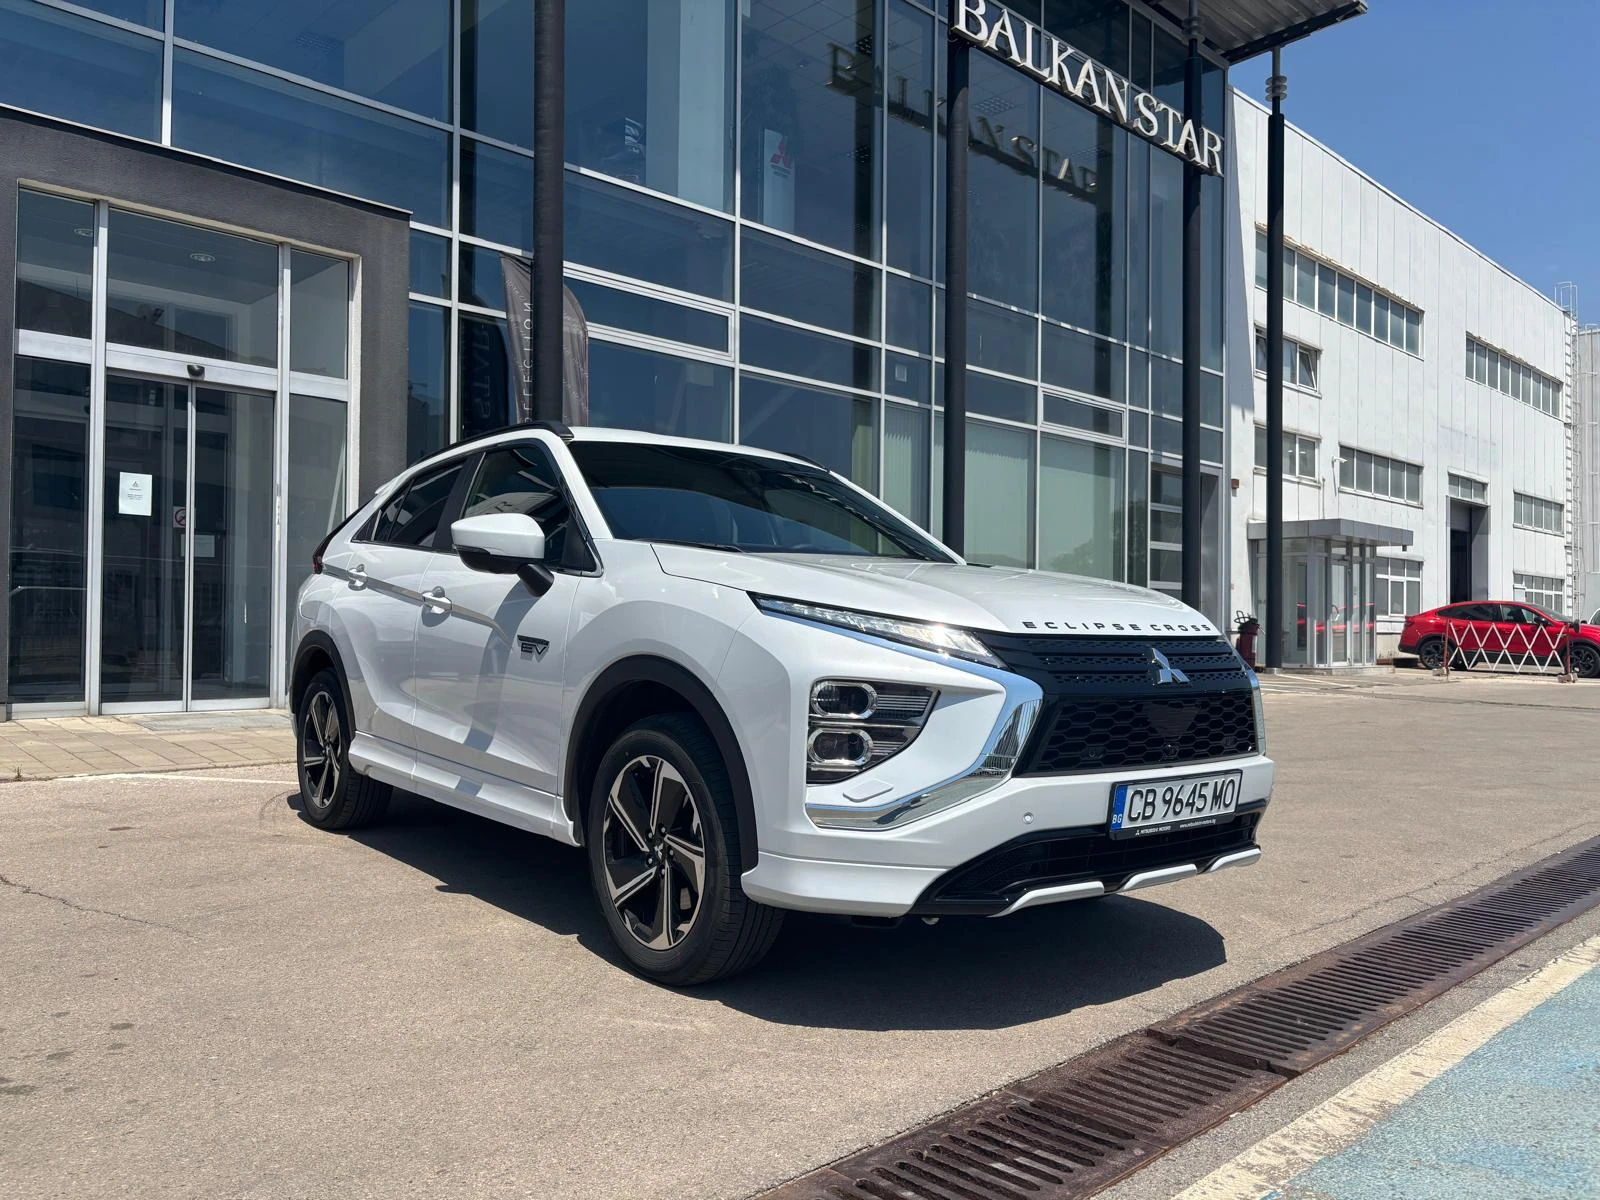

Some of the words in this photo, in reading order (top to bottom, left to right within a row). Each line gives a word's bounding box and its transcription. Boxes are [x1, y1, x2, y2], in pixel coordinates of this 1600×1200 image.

[950, 0, 1129, 124] BALKAN
[1133, 92, 1224, 177] STAR
[1022, 621, 1142, 631] ECLIPSE
[1150, 624, 1211, 632] CROSS
[1128, 789, 1157, 821] CB
[1162, 782, 1209, 818] 9645
[1210, 779, 1235, 812] MO
[1112, 814, 1122, 824] BG
